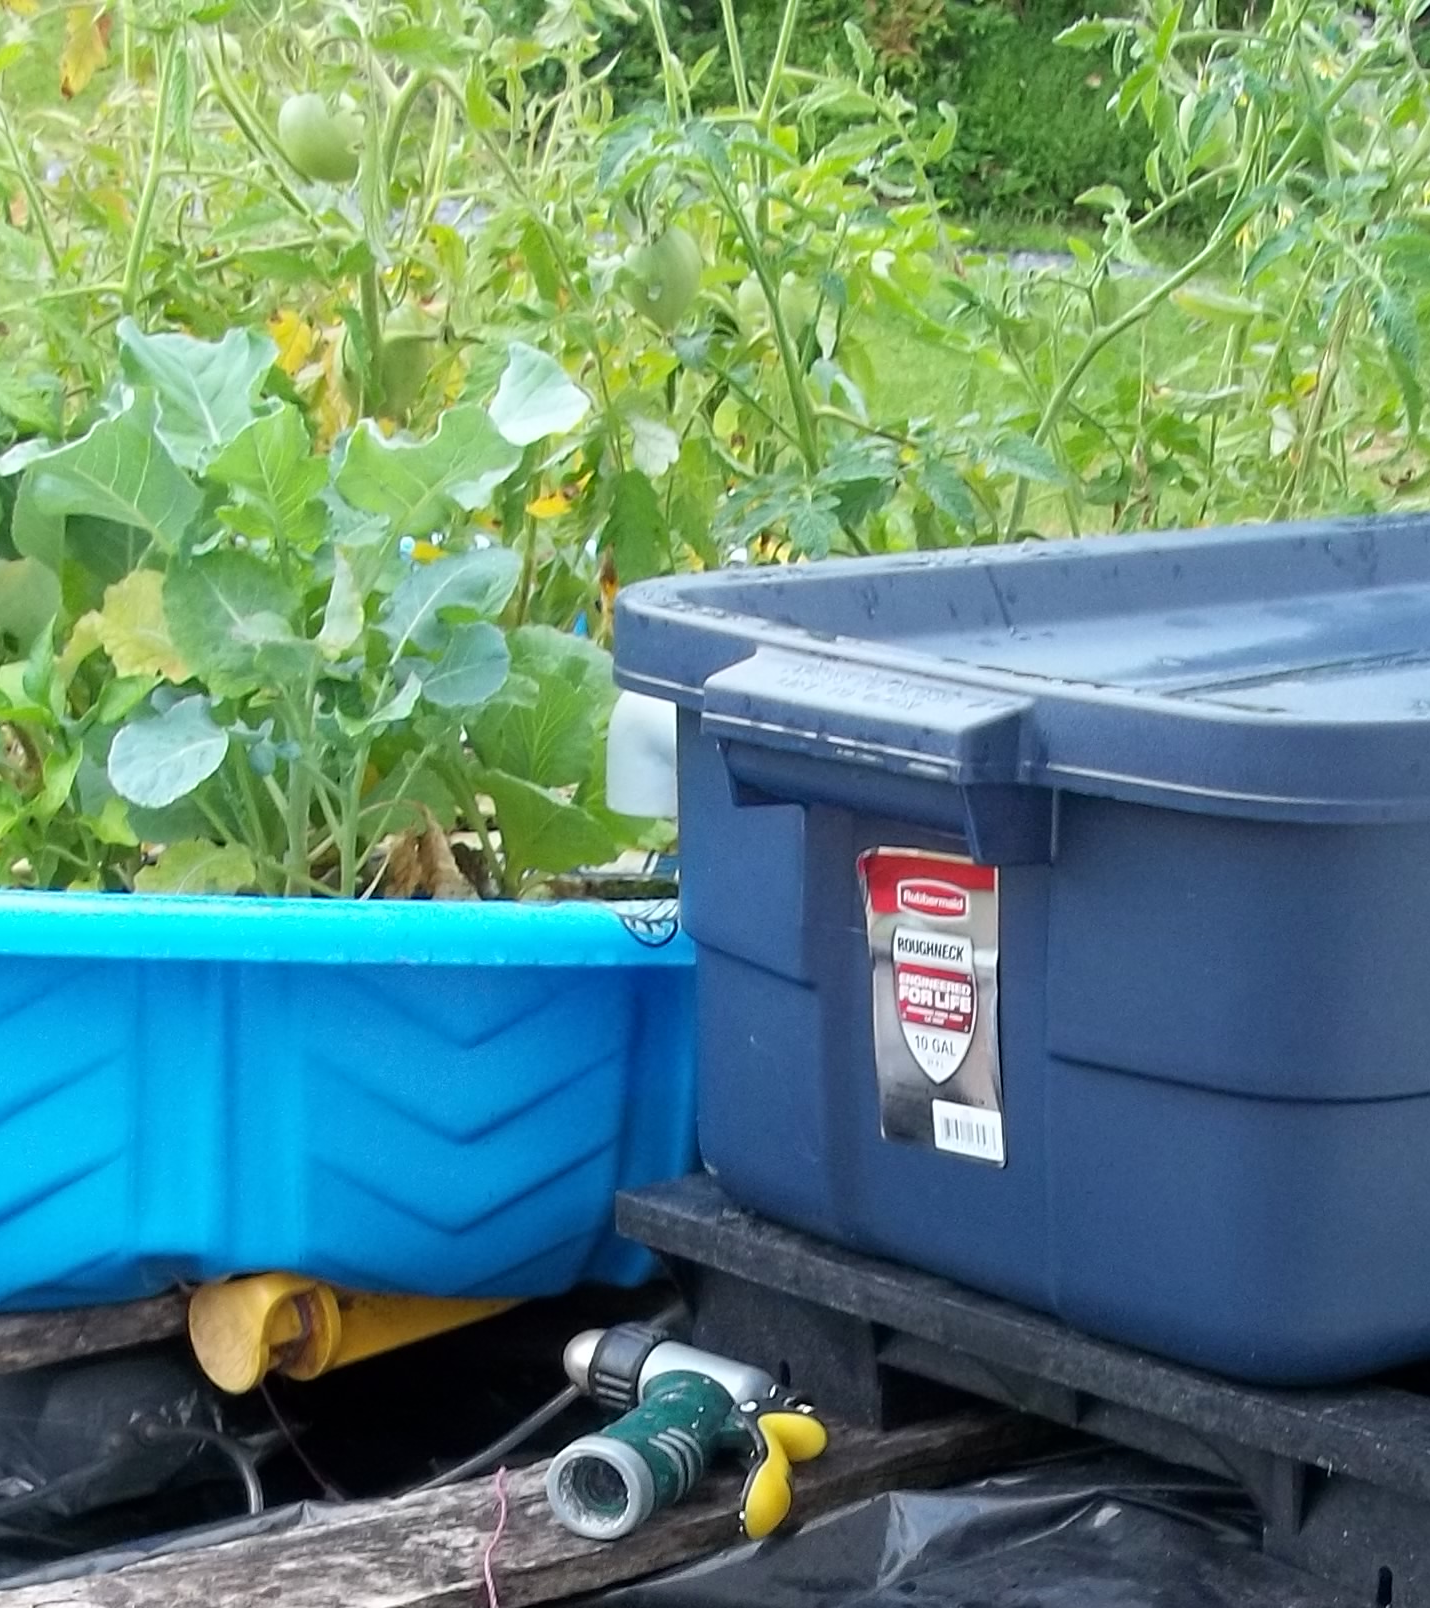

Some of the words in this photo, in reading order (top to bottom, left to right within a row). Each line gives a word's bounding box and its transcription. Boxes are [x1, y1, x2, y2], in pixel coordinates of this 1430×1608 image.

[902, 888, 964, 912] Rubbermaid
[897, 937, 965, 963] ROUGHNECK
[898, 972, 972, 997] ENGINEERED
[898, 984, 933, 1007] FOR
[934, 989, 972, 1014] LIFE
[914, 1034, 929, 1051] 10
[932, 1037, 957, 1057] GAL
